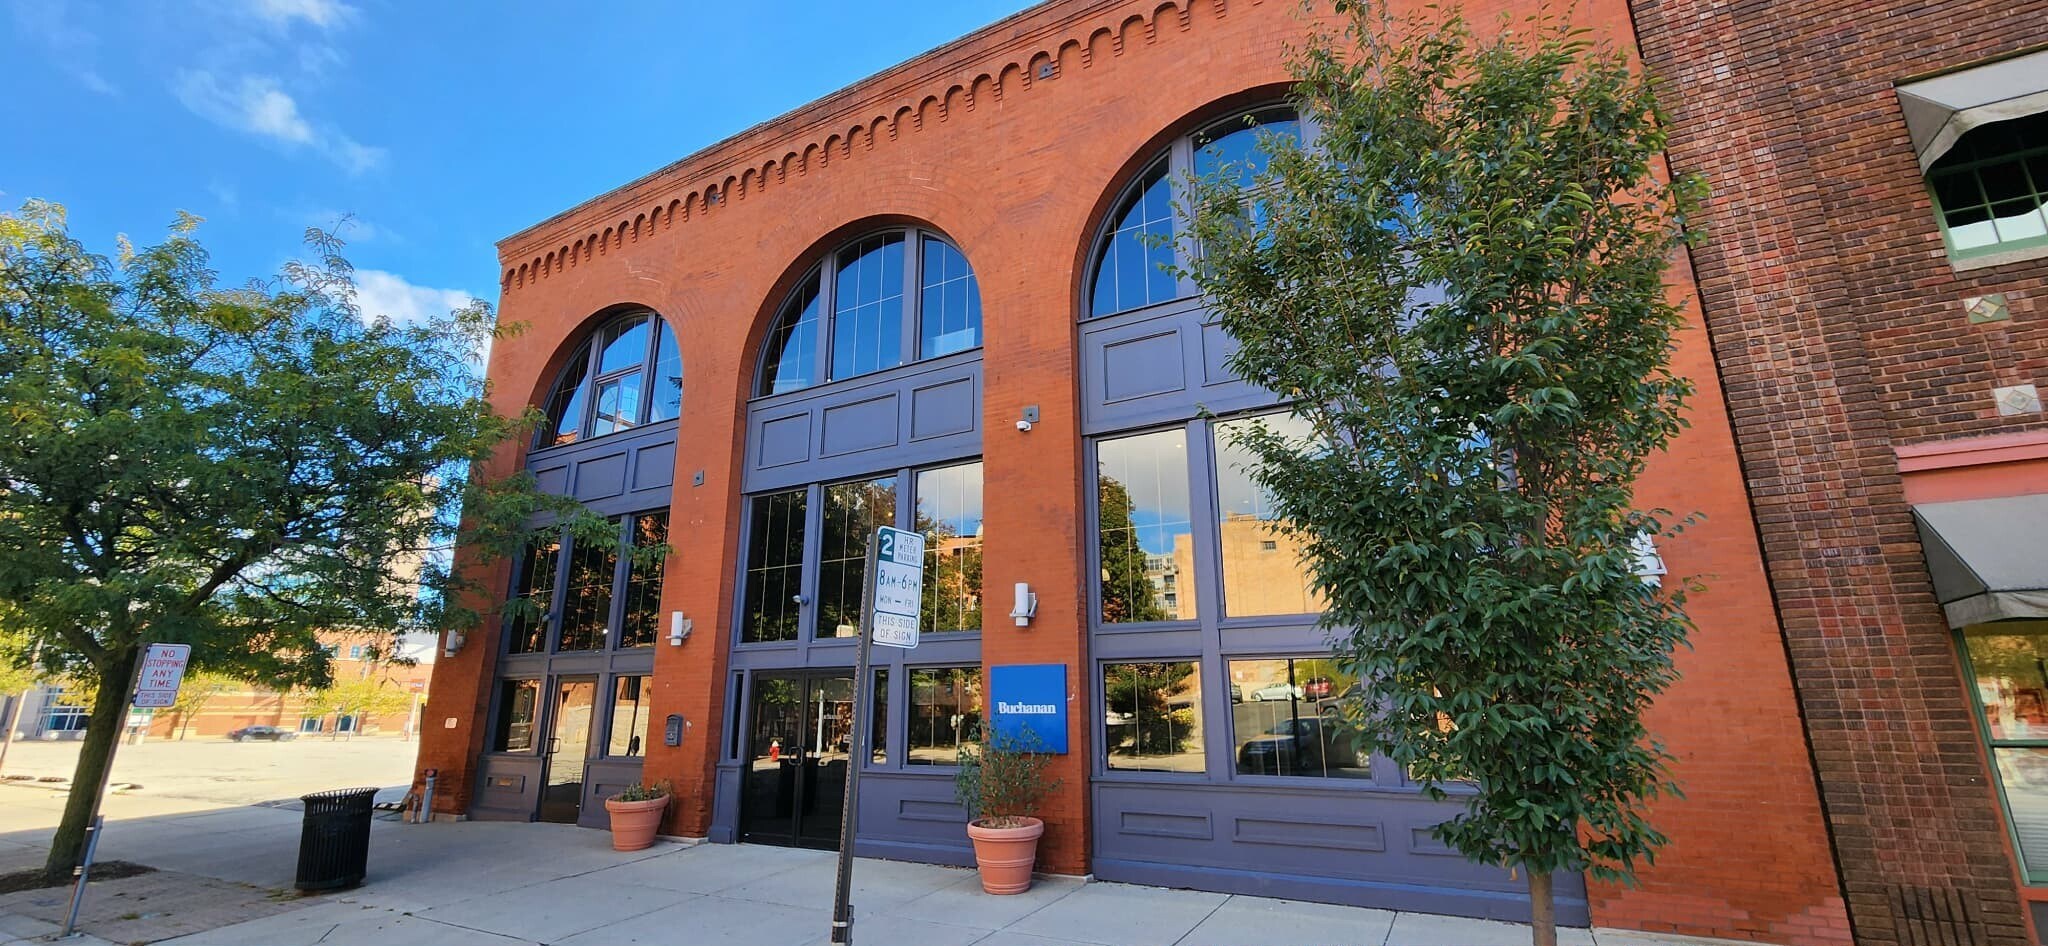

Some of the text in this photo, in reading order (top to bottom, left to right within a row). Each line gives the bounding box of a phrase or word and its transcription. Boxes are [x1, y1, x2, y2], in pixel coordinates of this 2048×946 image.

[882, 534, 893, 555] 2
[905, 536, 914, 545] HR
[899, 544, 917, 555] METER
[880, 595, 892, 604] MON
[905, 600, 914, 609] FRI
[879, 616, 915, 629] THIS SIDE
[881, 629, 912, 640] OF SIGN
[161, 650, 175, 658] NO
[147, 660, 184, 668] STOPPING
[152, 670, 173, 678] ANY
[149, 680, 171, 688] TIME
[998, 702, 1056, 714] Buchanan
